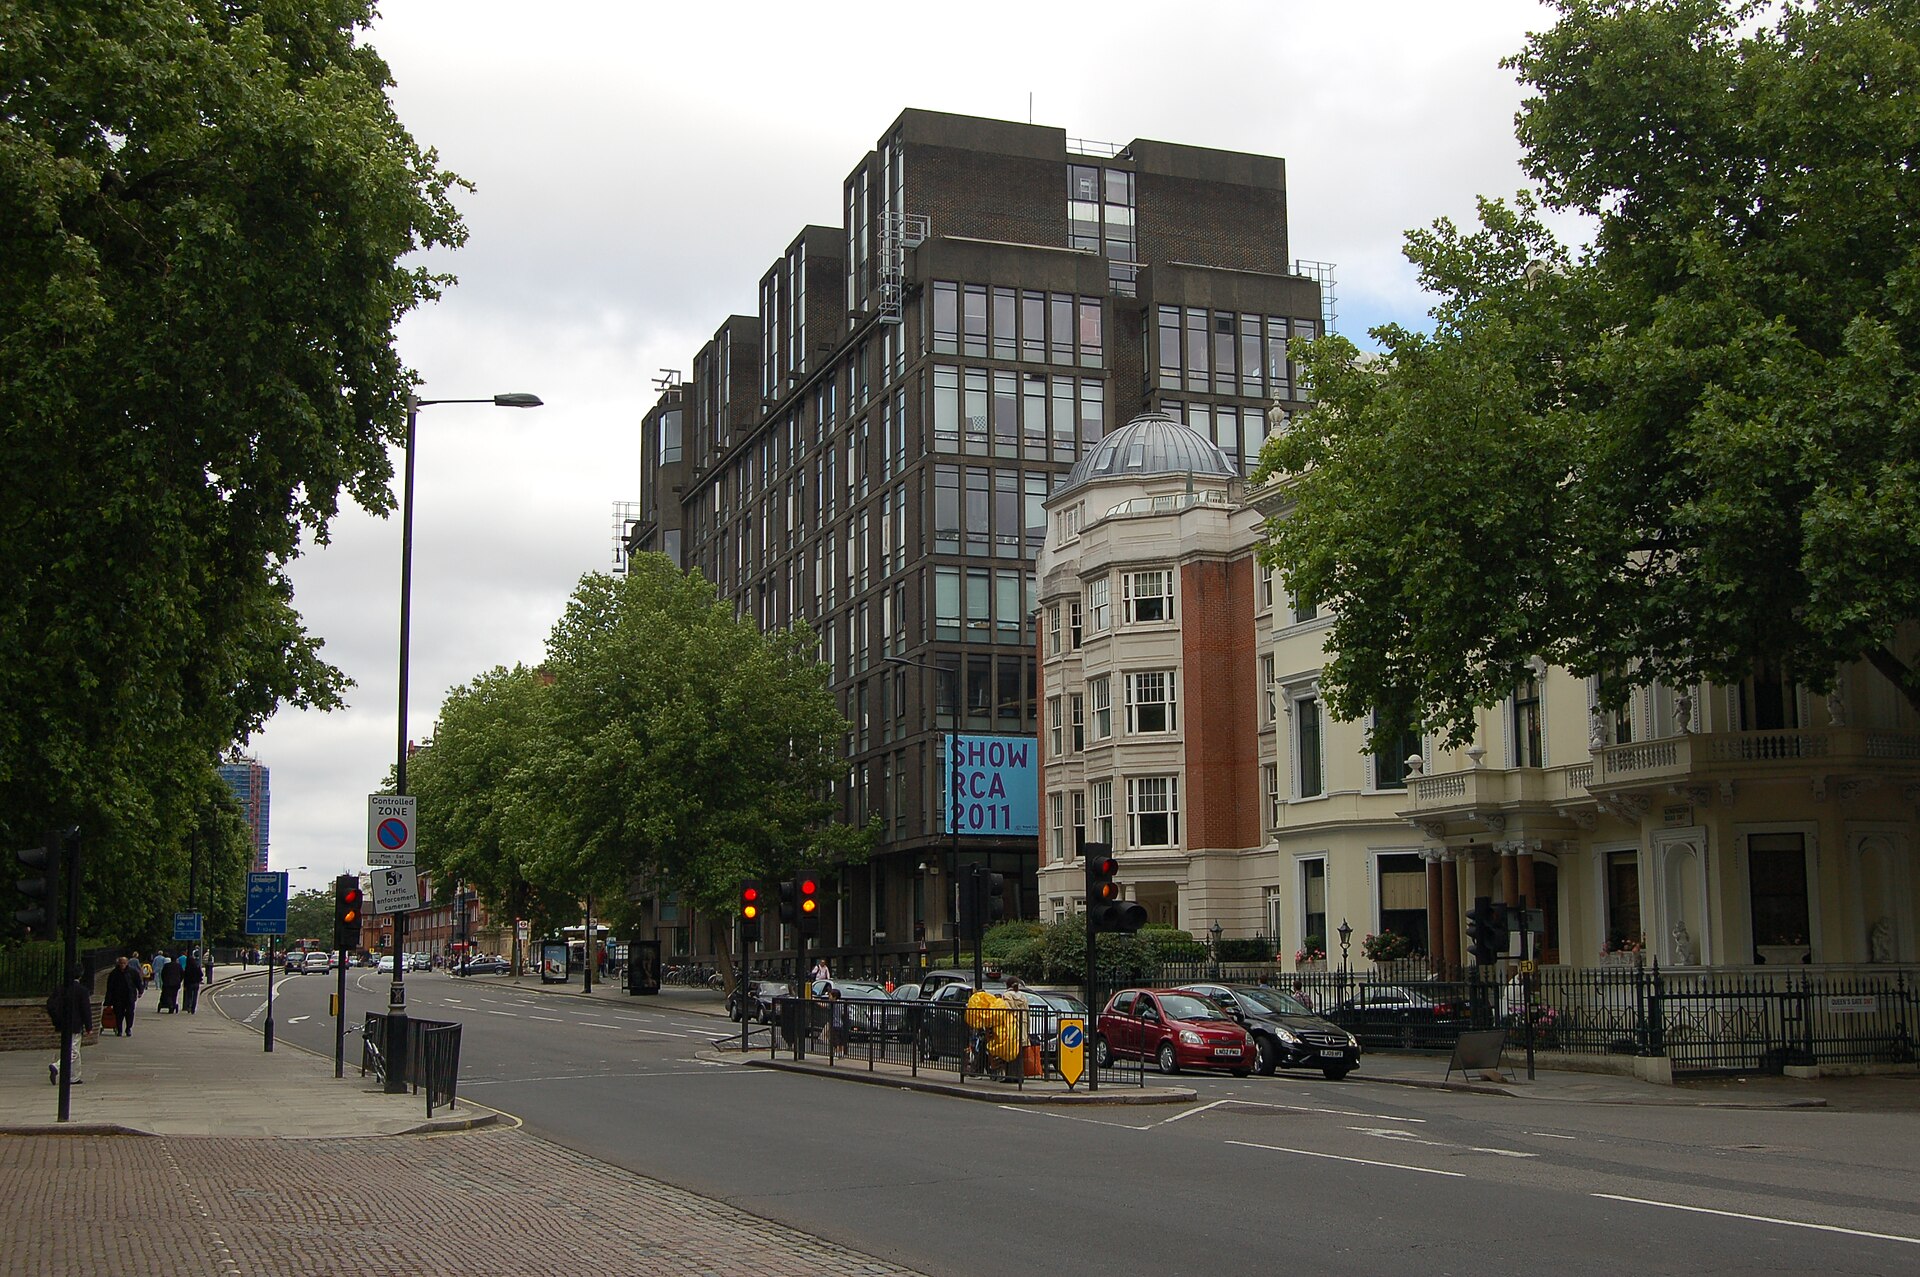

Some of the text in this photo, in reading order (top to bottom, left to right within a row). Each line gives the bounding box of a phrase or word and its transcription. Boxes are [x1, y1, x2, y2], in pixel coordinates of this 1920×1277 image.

[950, 739, 1028, 768] SHOW
[951, 771, 1006, 799] RCA
[378, 806, 408, 816] ZONE
[950, 803, 1010, 830] 2011
[377, 894, 416, 904] enforcement
[384, 903, 410, 911] cameras
